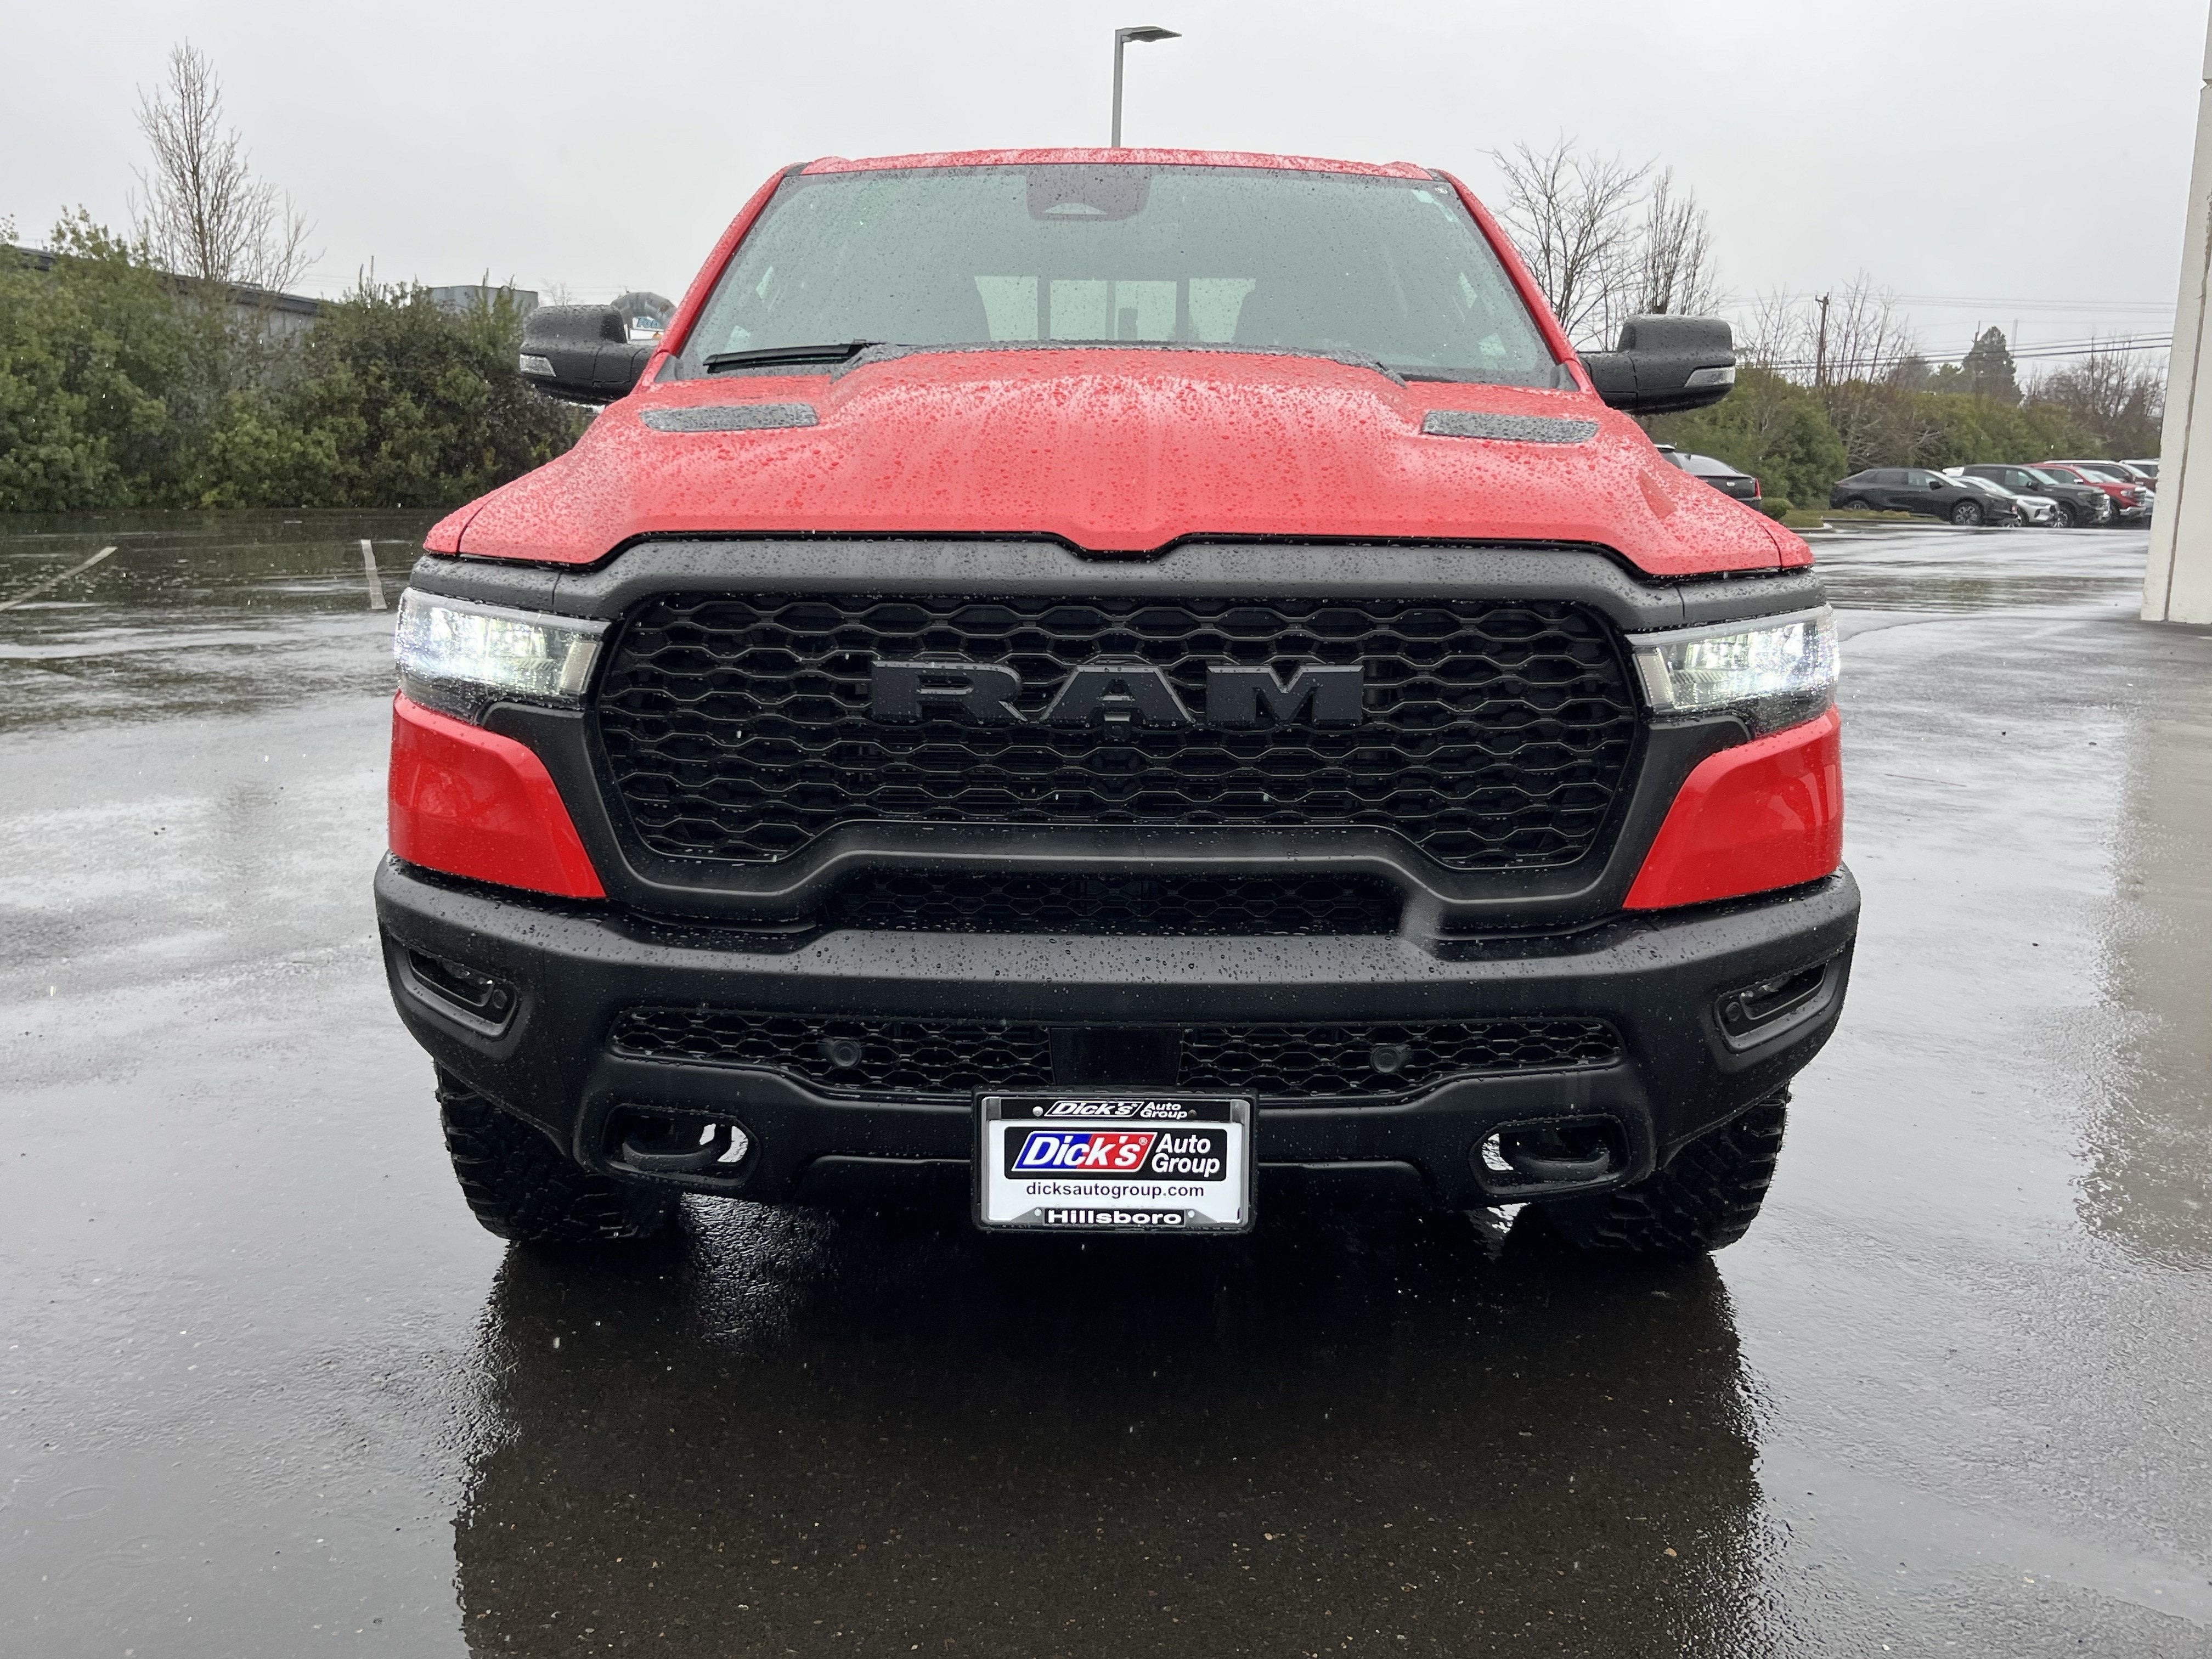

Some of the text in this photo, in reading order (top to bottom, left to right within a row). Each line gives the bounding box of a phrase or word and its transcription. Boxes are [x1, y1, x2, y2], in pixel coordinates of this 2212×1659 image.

[872, 659, 1364, 726] RAM
[1052, 1103, 1133, 1115] Dick's
[1140, 1109, 1188, 1120] Group
[1142, 1102, 1181, 1110] Auto
[1022, 1135, 1141, 1166] Dick's
[1156, 1133, 1211, 1154] Auto
[1152, 1154, 1220, 1177] Group
[1026, 1182, 1204, 1199] dicksautogroup.com
[1047, 1210, 1182, 1224] Hillsboro
